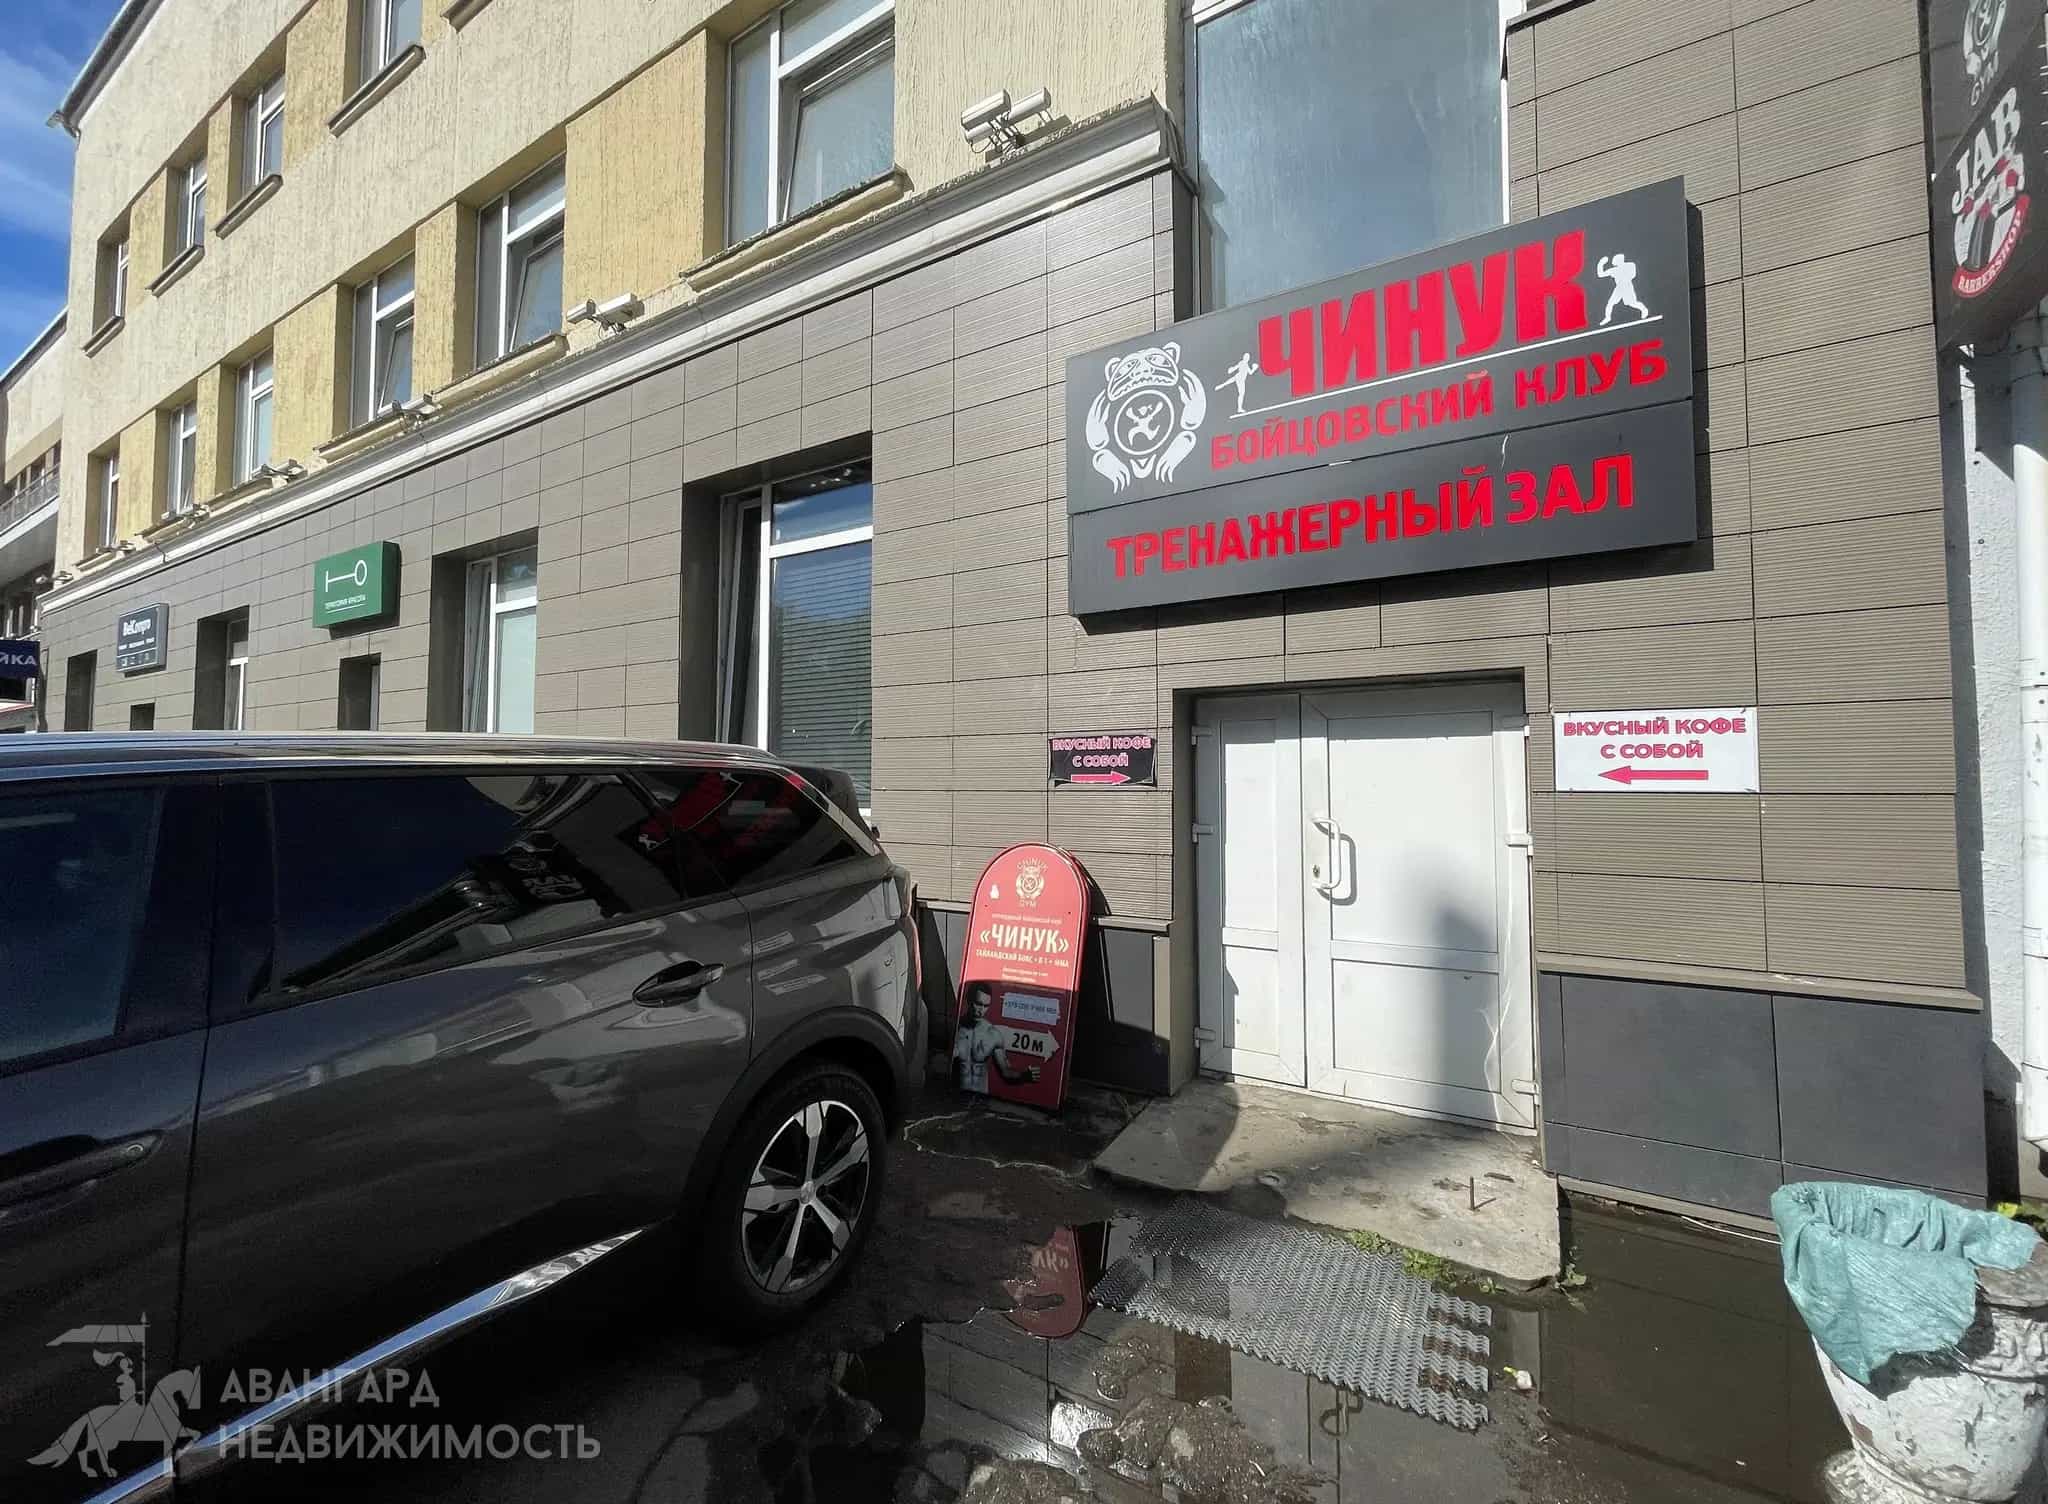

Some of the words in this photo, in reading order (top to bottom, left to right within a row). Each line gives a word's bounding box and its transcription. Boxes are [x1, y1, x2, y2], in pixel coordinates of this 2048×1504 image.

[1258, 229, 1589, 398] ЧИНУК
[1210, 371, 1494, 471] БОЙЦОВСКИЙ
[1514, 338, 1668, 411] КЛУБ
[1106, 465, 1494, 579] ТРЕНАЖЕРНЫЙ
[1505, 453, 1634, 524] ЗАЛ
[1563, 716, 1670, 737] ВКУСНЫЙ
[1675, 717, 1746, 735] КОФЕ
[1053, 736, 1111, 751] ВКУСНЫЙ
[1112, 735, 1152, 751] КОФЕ
[1600, 744, 1616, 759] С
[1619, 740, 1704, 759] СОБОЙ
[1072, 755, 1083, 768] С
[1083, 752, 1129, 768] СОБОЙ
[980, 923, 1069, 954] «ЧИНУК»
[1011, 1032, 1031, 1050] 20
